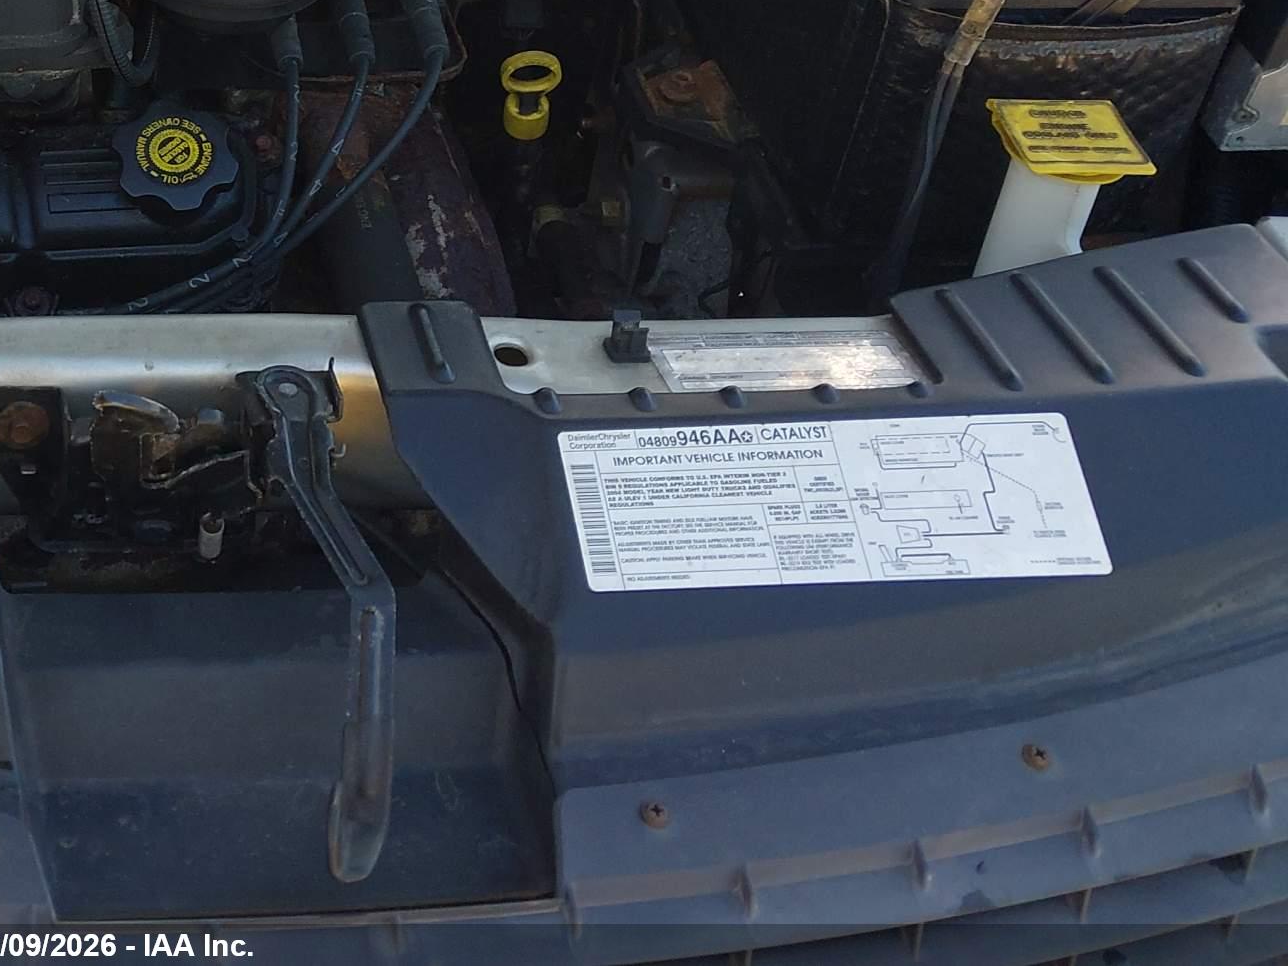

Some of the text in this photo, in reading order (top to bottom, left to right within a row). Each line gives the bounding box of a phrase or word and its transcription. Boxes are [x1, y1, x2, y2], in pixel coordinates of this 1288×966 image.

[136, 118, 202, 172] SEE OWNERS MANUAL
[160, 142, 212, 184] ENGINE OIL
[568, 433, 631, 442] DaimlerChrysler
[638, 429, 742, 448] 04809946AA
[760, 426, 827, 440] CATALYST
[613, 450, 823, 466] IMPORTANT VEHICLE INFORMATION
